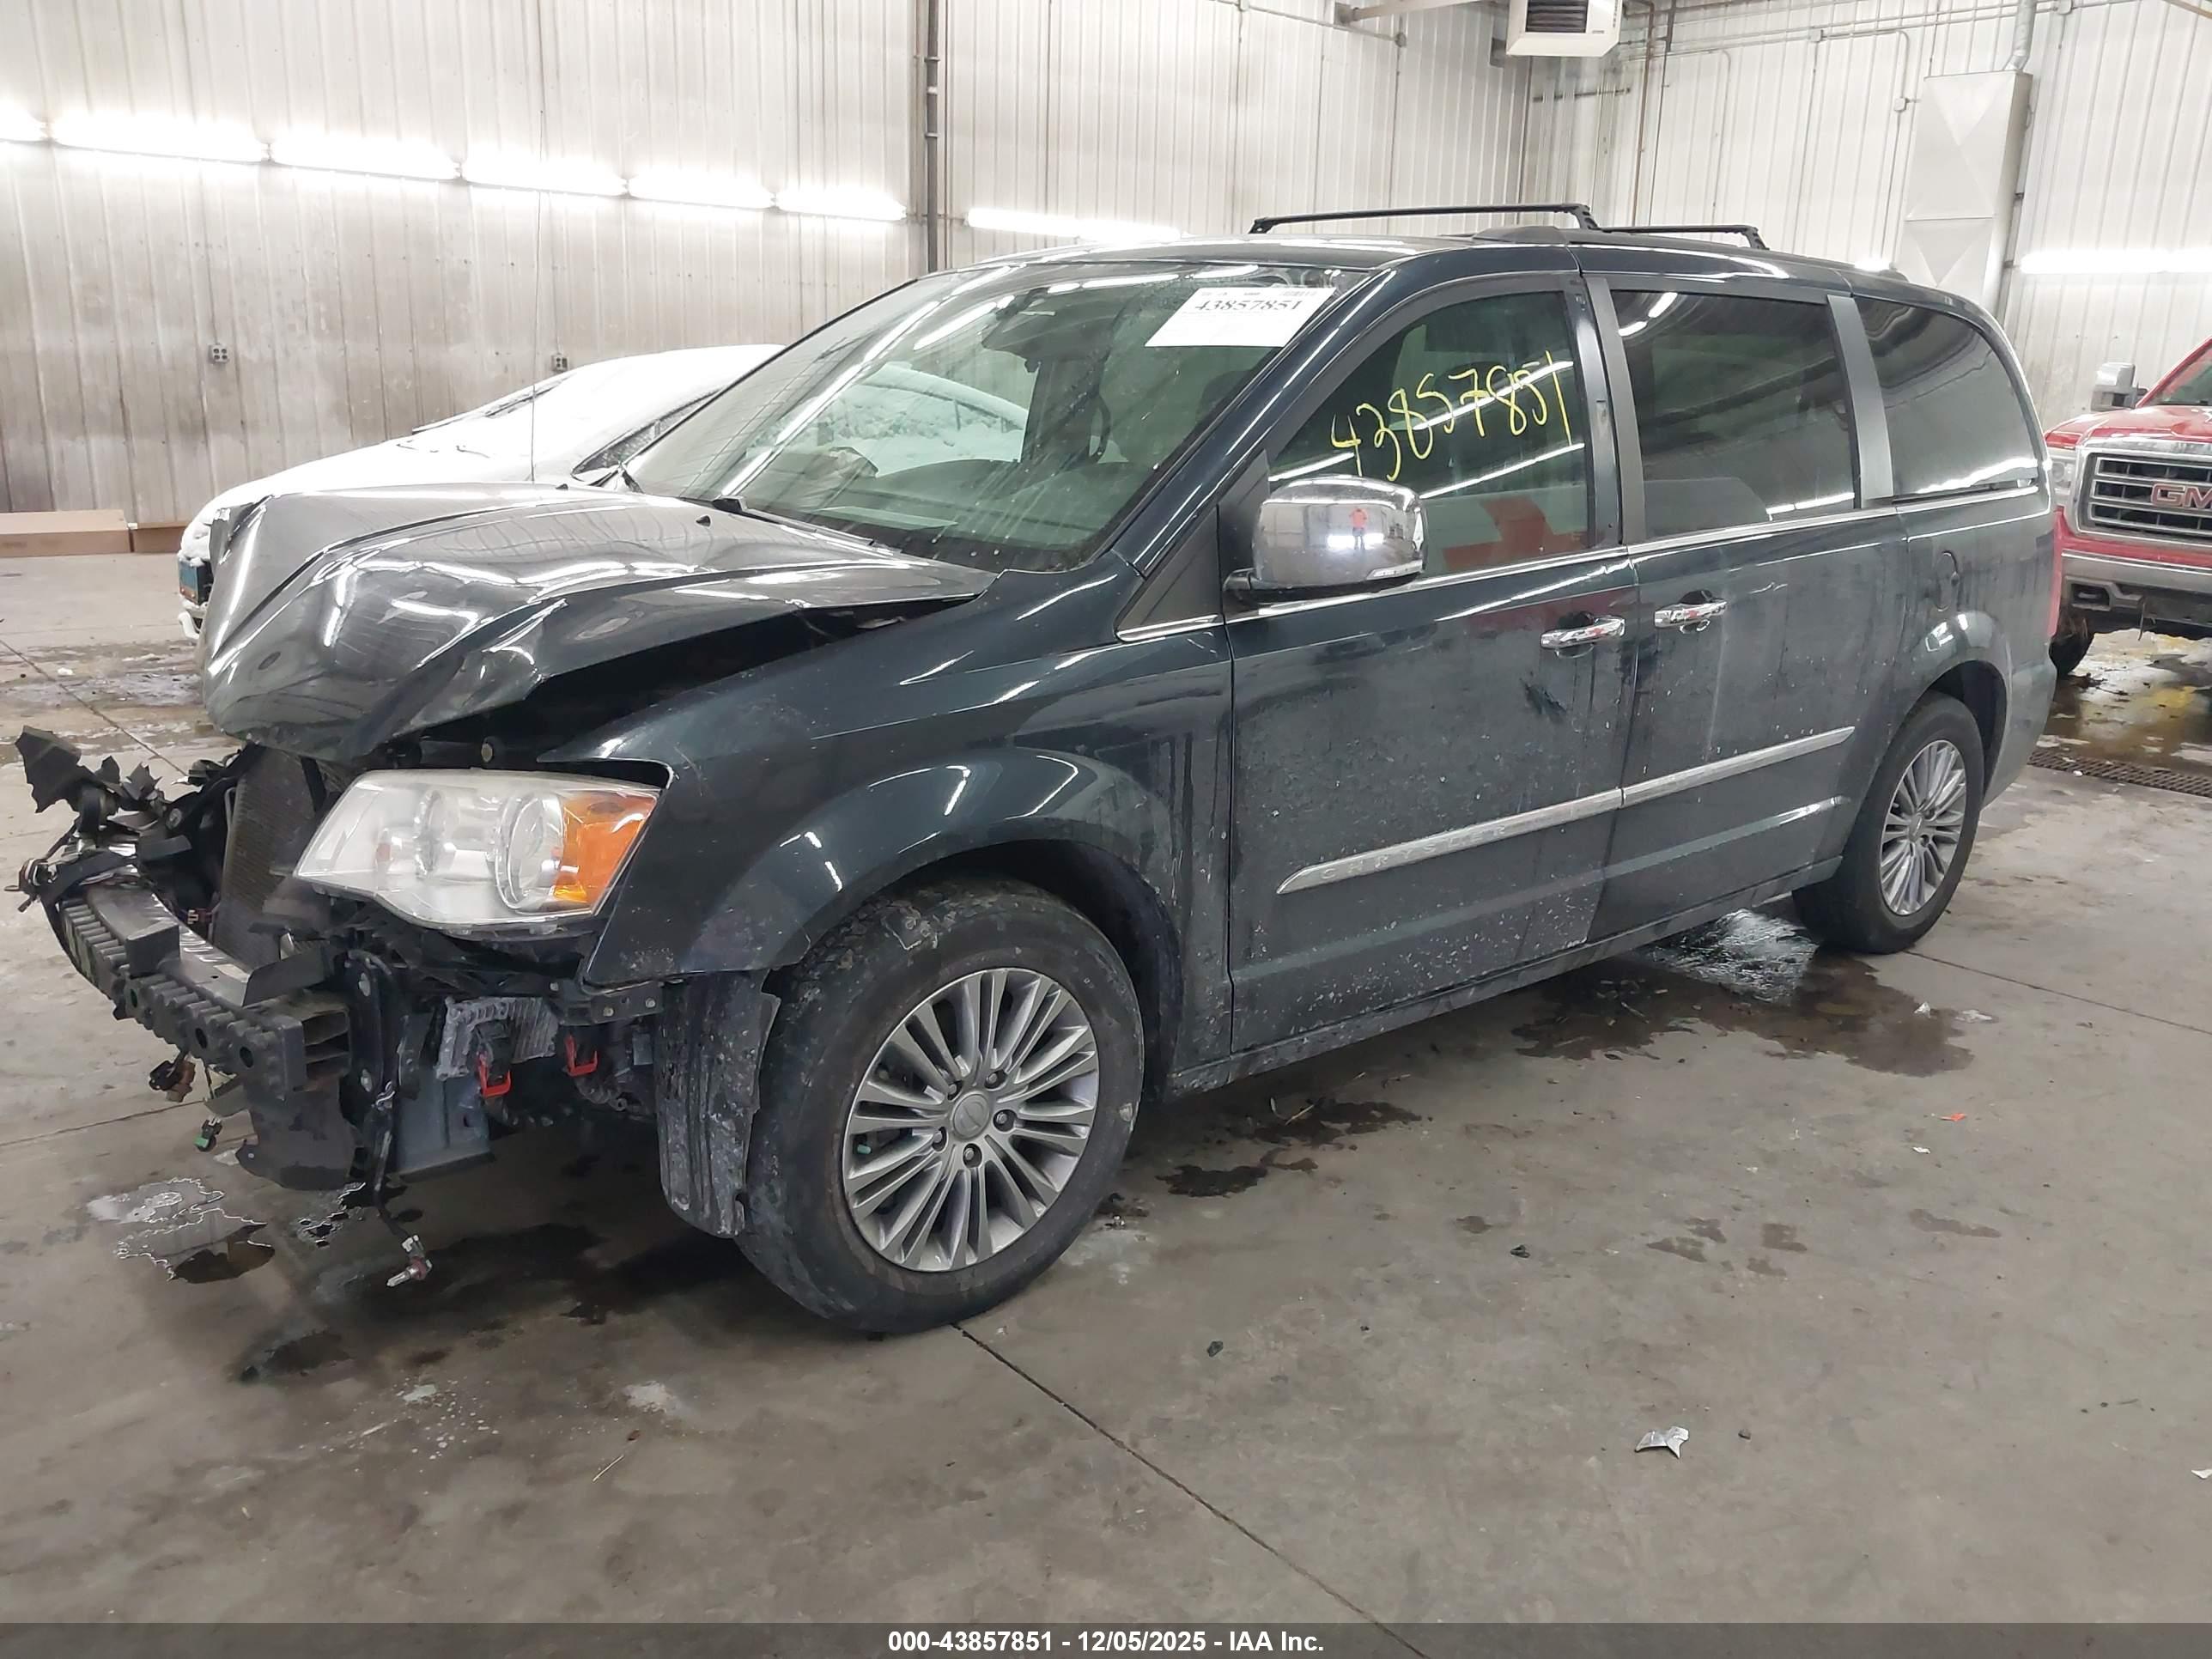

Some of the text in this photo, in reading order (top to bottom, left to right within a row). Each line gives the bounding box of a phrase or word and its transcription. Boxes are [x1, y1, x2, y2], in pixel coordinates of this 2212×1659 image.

[1194, 300, 1303, 311] 43857851
[1330, 349, 1571, 482] 43857851
[1320, 824, 1507, 880] CHRYSLER
